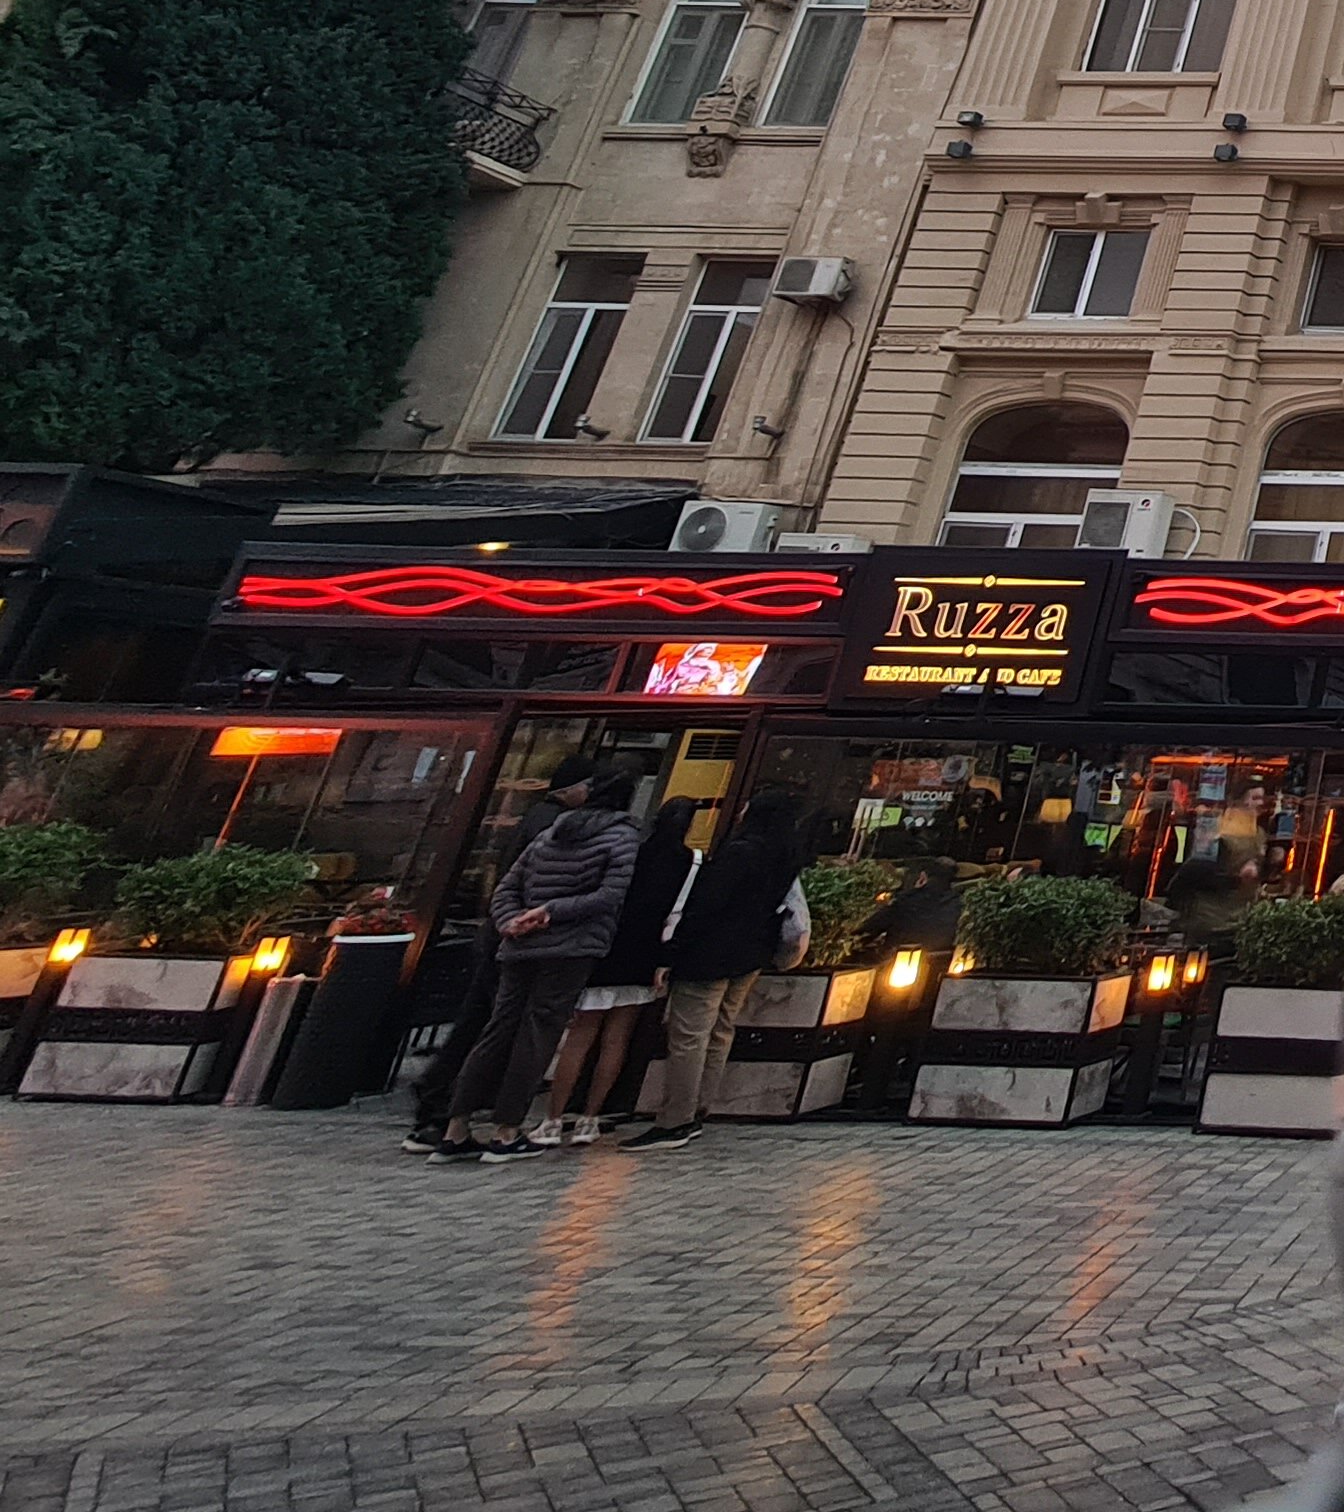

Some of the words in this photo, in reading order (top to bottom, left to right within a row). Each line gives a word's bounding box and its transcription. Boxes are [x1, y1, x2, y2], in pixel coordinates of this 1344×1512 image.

[884, 586, 1069, 641] Ruzza
[863, 665, 977, 683] RESTAURANT
[977, 668, 1015, 683] AD
[1016, 669, 1063, 685] CAFE
[902, 790, 954, 802] WELCOME
